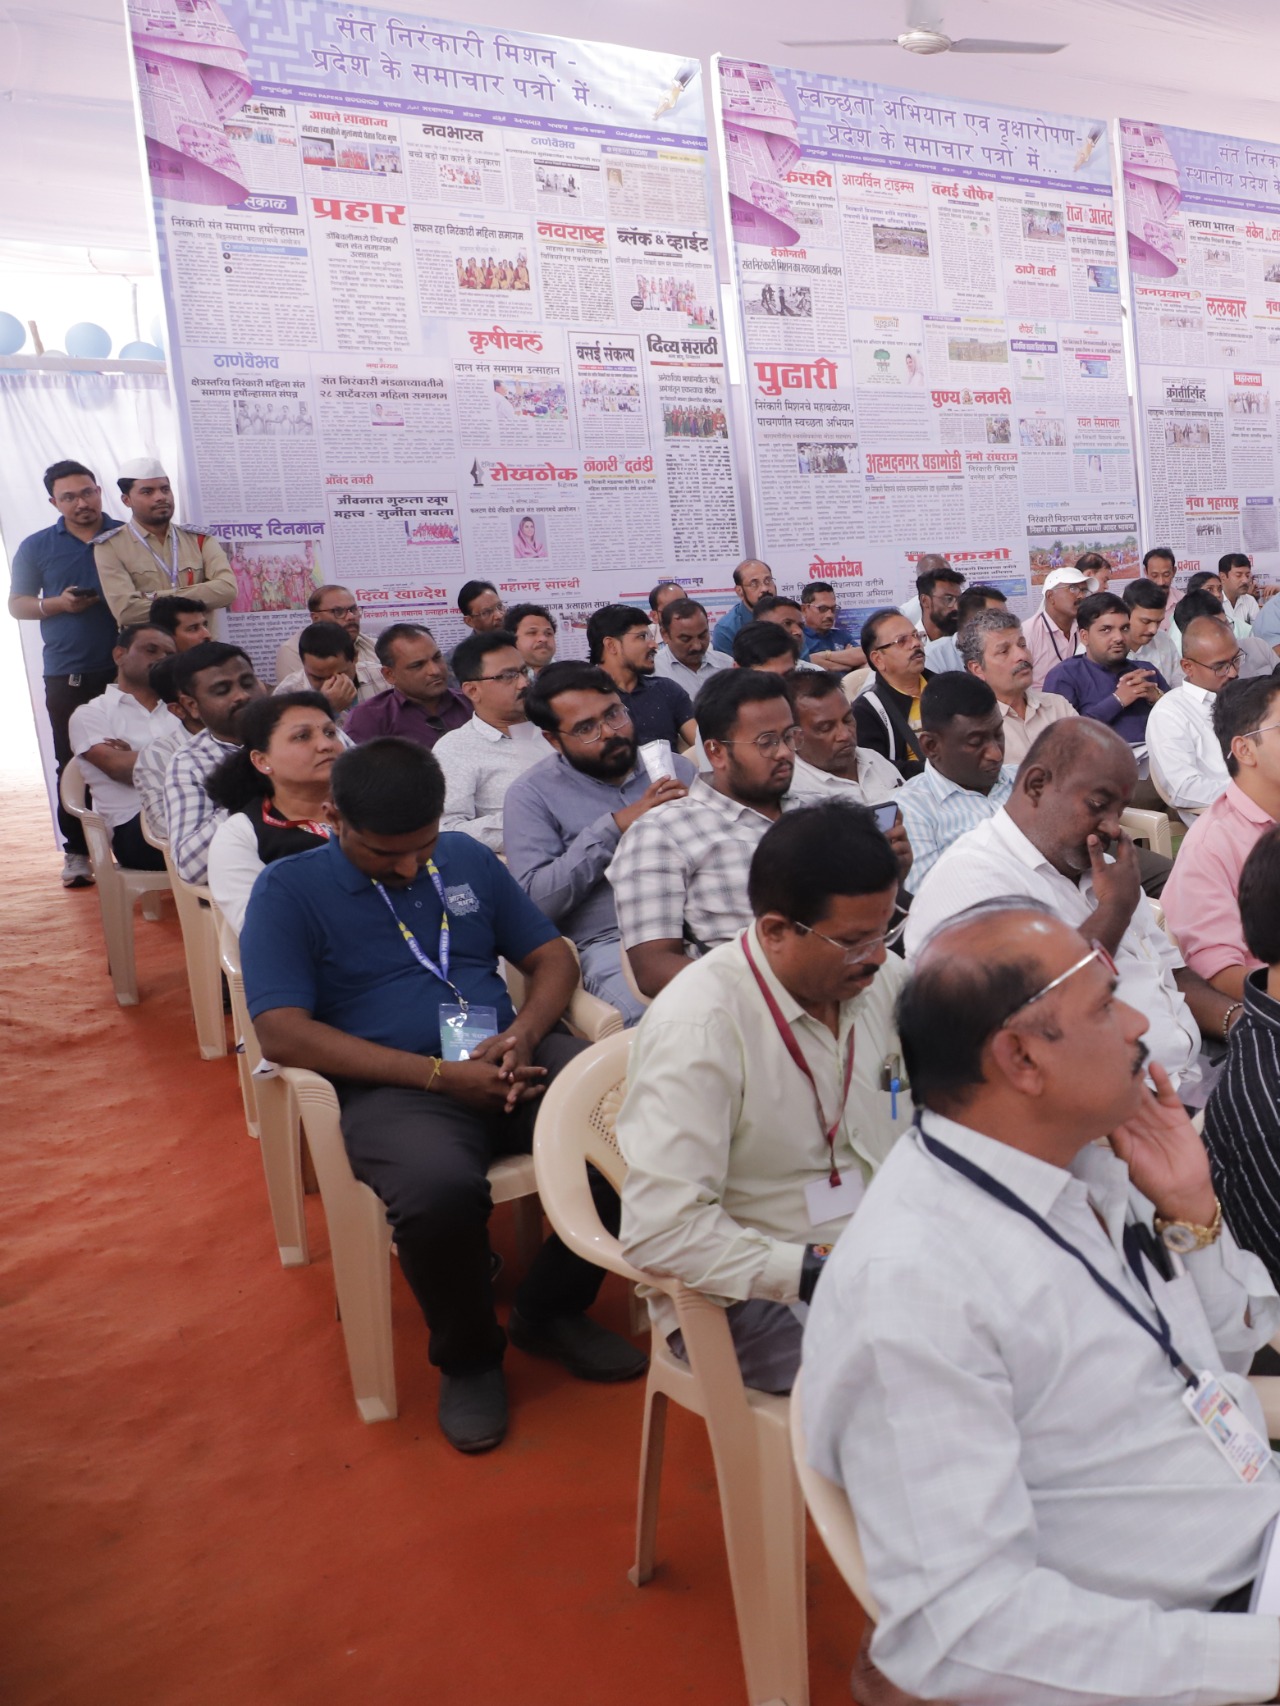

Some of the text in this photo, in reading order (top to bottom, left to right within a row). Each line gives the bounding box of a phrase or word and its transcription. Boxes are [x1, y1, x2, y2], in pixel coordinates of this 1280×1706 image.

[336, 13, 557, 70] संत निरंकारी मिशन
[311, 43, 371, 78] प्रदेश
[379, 51, 402, 81] के
[411, 63, 505, 96] समाचार
[513, 74, 562, 102] पत्रों
[309, 110, 341, 122] आपले
[797, 86, 874, 116] स्वच्छता
[883, 96, 956, 129] अभियान
[422, 123, 483, 143] नवभारत
[827, 119, 872, 147] प्रदेश
[879, 125, 895, 150] के
[903, 134, 974, 163] समाचार
[980, 142, 1018, 167] पत्रों
[1219, 144, 1239, 163] संत
[1186, 166, 1233, 187] स्थानीय
[1239, 172, 1268, 193] प्रदेश
[932, 183, 959, 198] वसई
[310, 197, 407, 226] प्रहार
[1066, 203, 1083, 222] राज
[171, 215, 206, 230] निरंकारी
[208, 219, 223, 231] संत
[225, 221, 256, 233] समागम
[536, 220, 606, 244] नवराष्ट्र
[1188, 218, 1235, 234] तरुण भारत
[617, 227, 709, 252] ब्लॅक & व्हाईट
[1206, 300, 1247, 319] ललकार
[467, 325, 543, 355] कृषीवल
[646, 333, 718, 355] दिव्य मराठी
[213, 351, 280, 369] ठाणेवैभव
[576, 340, 602, 362] वसई
[454, 362, 472, 373] बाल
[476, 362, 490, 374] संत
[493, 364, 523, 374] समागम
[754, 357, 838, 396] पुढारी
[320, 376, 378, 388] संत निरंकारी
[755, 399, 811, 412] निरंकारी मिशनचे
[930, 387, 1012, 408] पुण्य नगरी
[795, 418, 823, 429] स्वच्छता
[826, 418, 854, 429] अभियान
[1094, 417, 1119, 429] समाचार
[866, 450, 962, 474] अहमदनगर घडामोडी
[351, 474, 374, 485] नगरी
[490, 462, 578, 482] रोखठोक
[337, 494, 383, 506] जीवनात
[377, 506, 454, 520] सुनीता चावला
[268, 518, 325, 537] दिनमान
[808, 554, 863, 580] लोकमंथन
[356, 587, 389, 602] दिव्य
[499, 577, 580, 593] महाराष्ट्र सारथी
